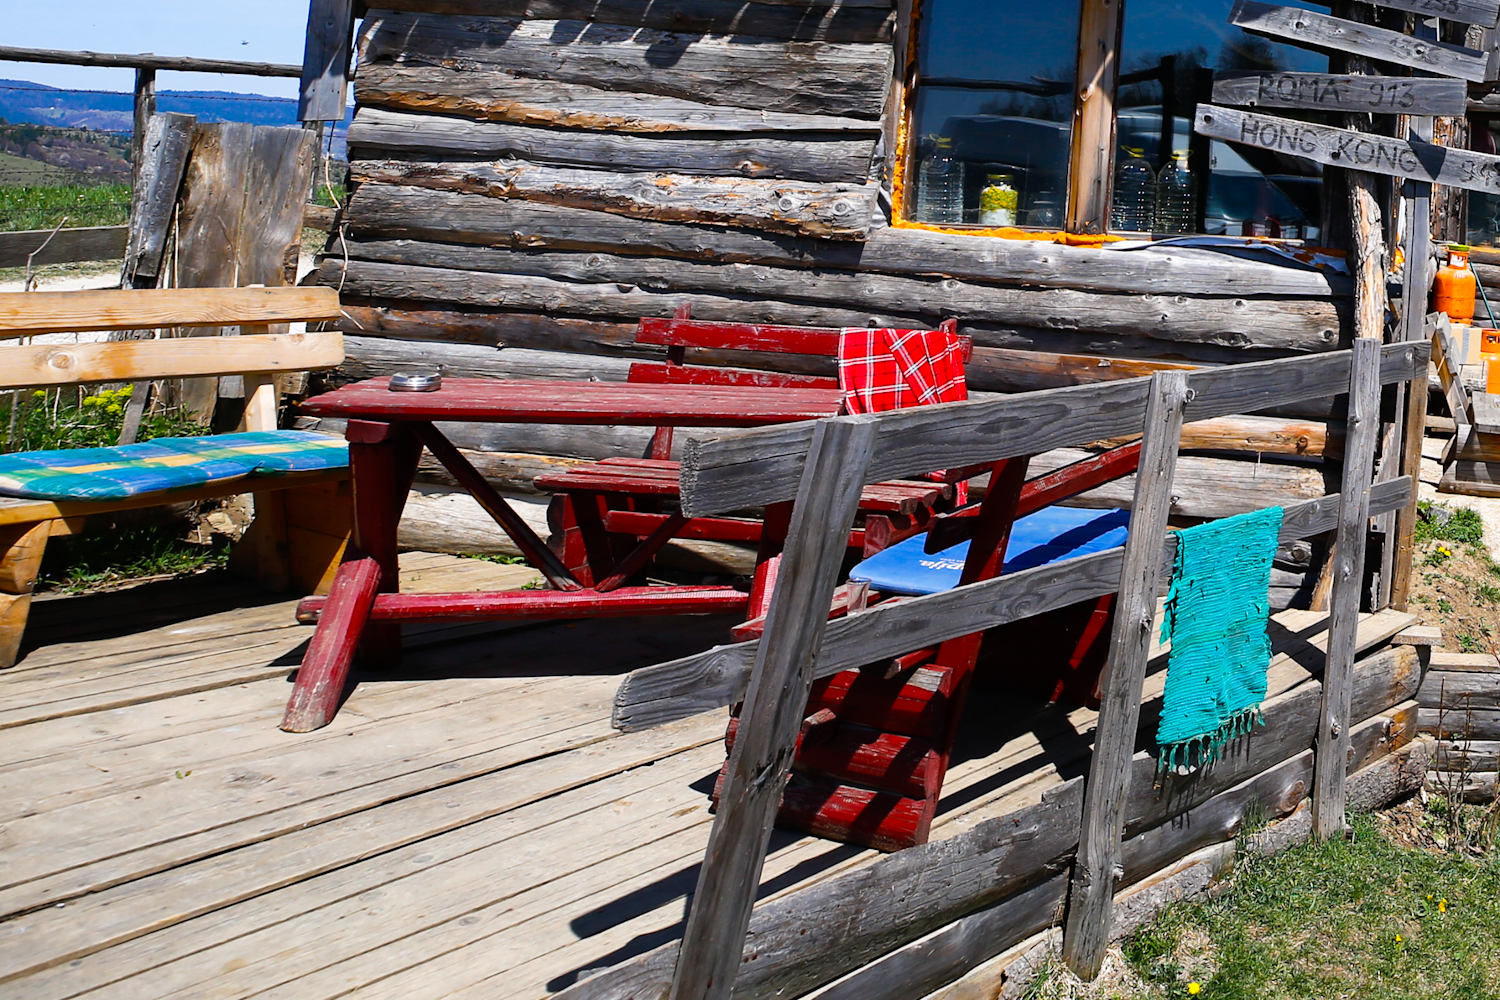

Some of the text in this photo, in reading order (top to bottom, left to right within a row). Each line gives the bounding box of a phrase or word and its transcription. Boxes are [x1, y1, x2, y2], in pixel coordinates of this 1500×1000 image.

[1258, 75, 1416, 108] ROMA 913
[1240, 118, 1318, 154] HONG
[1337, 134, 1418, 172] KONG
